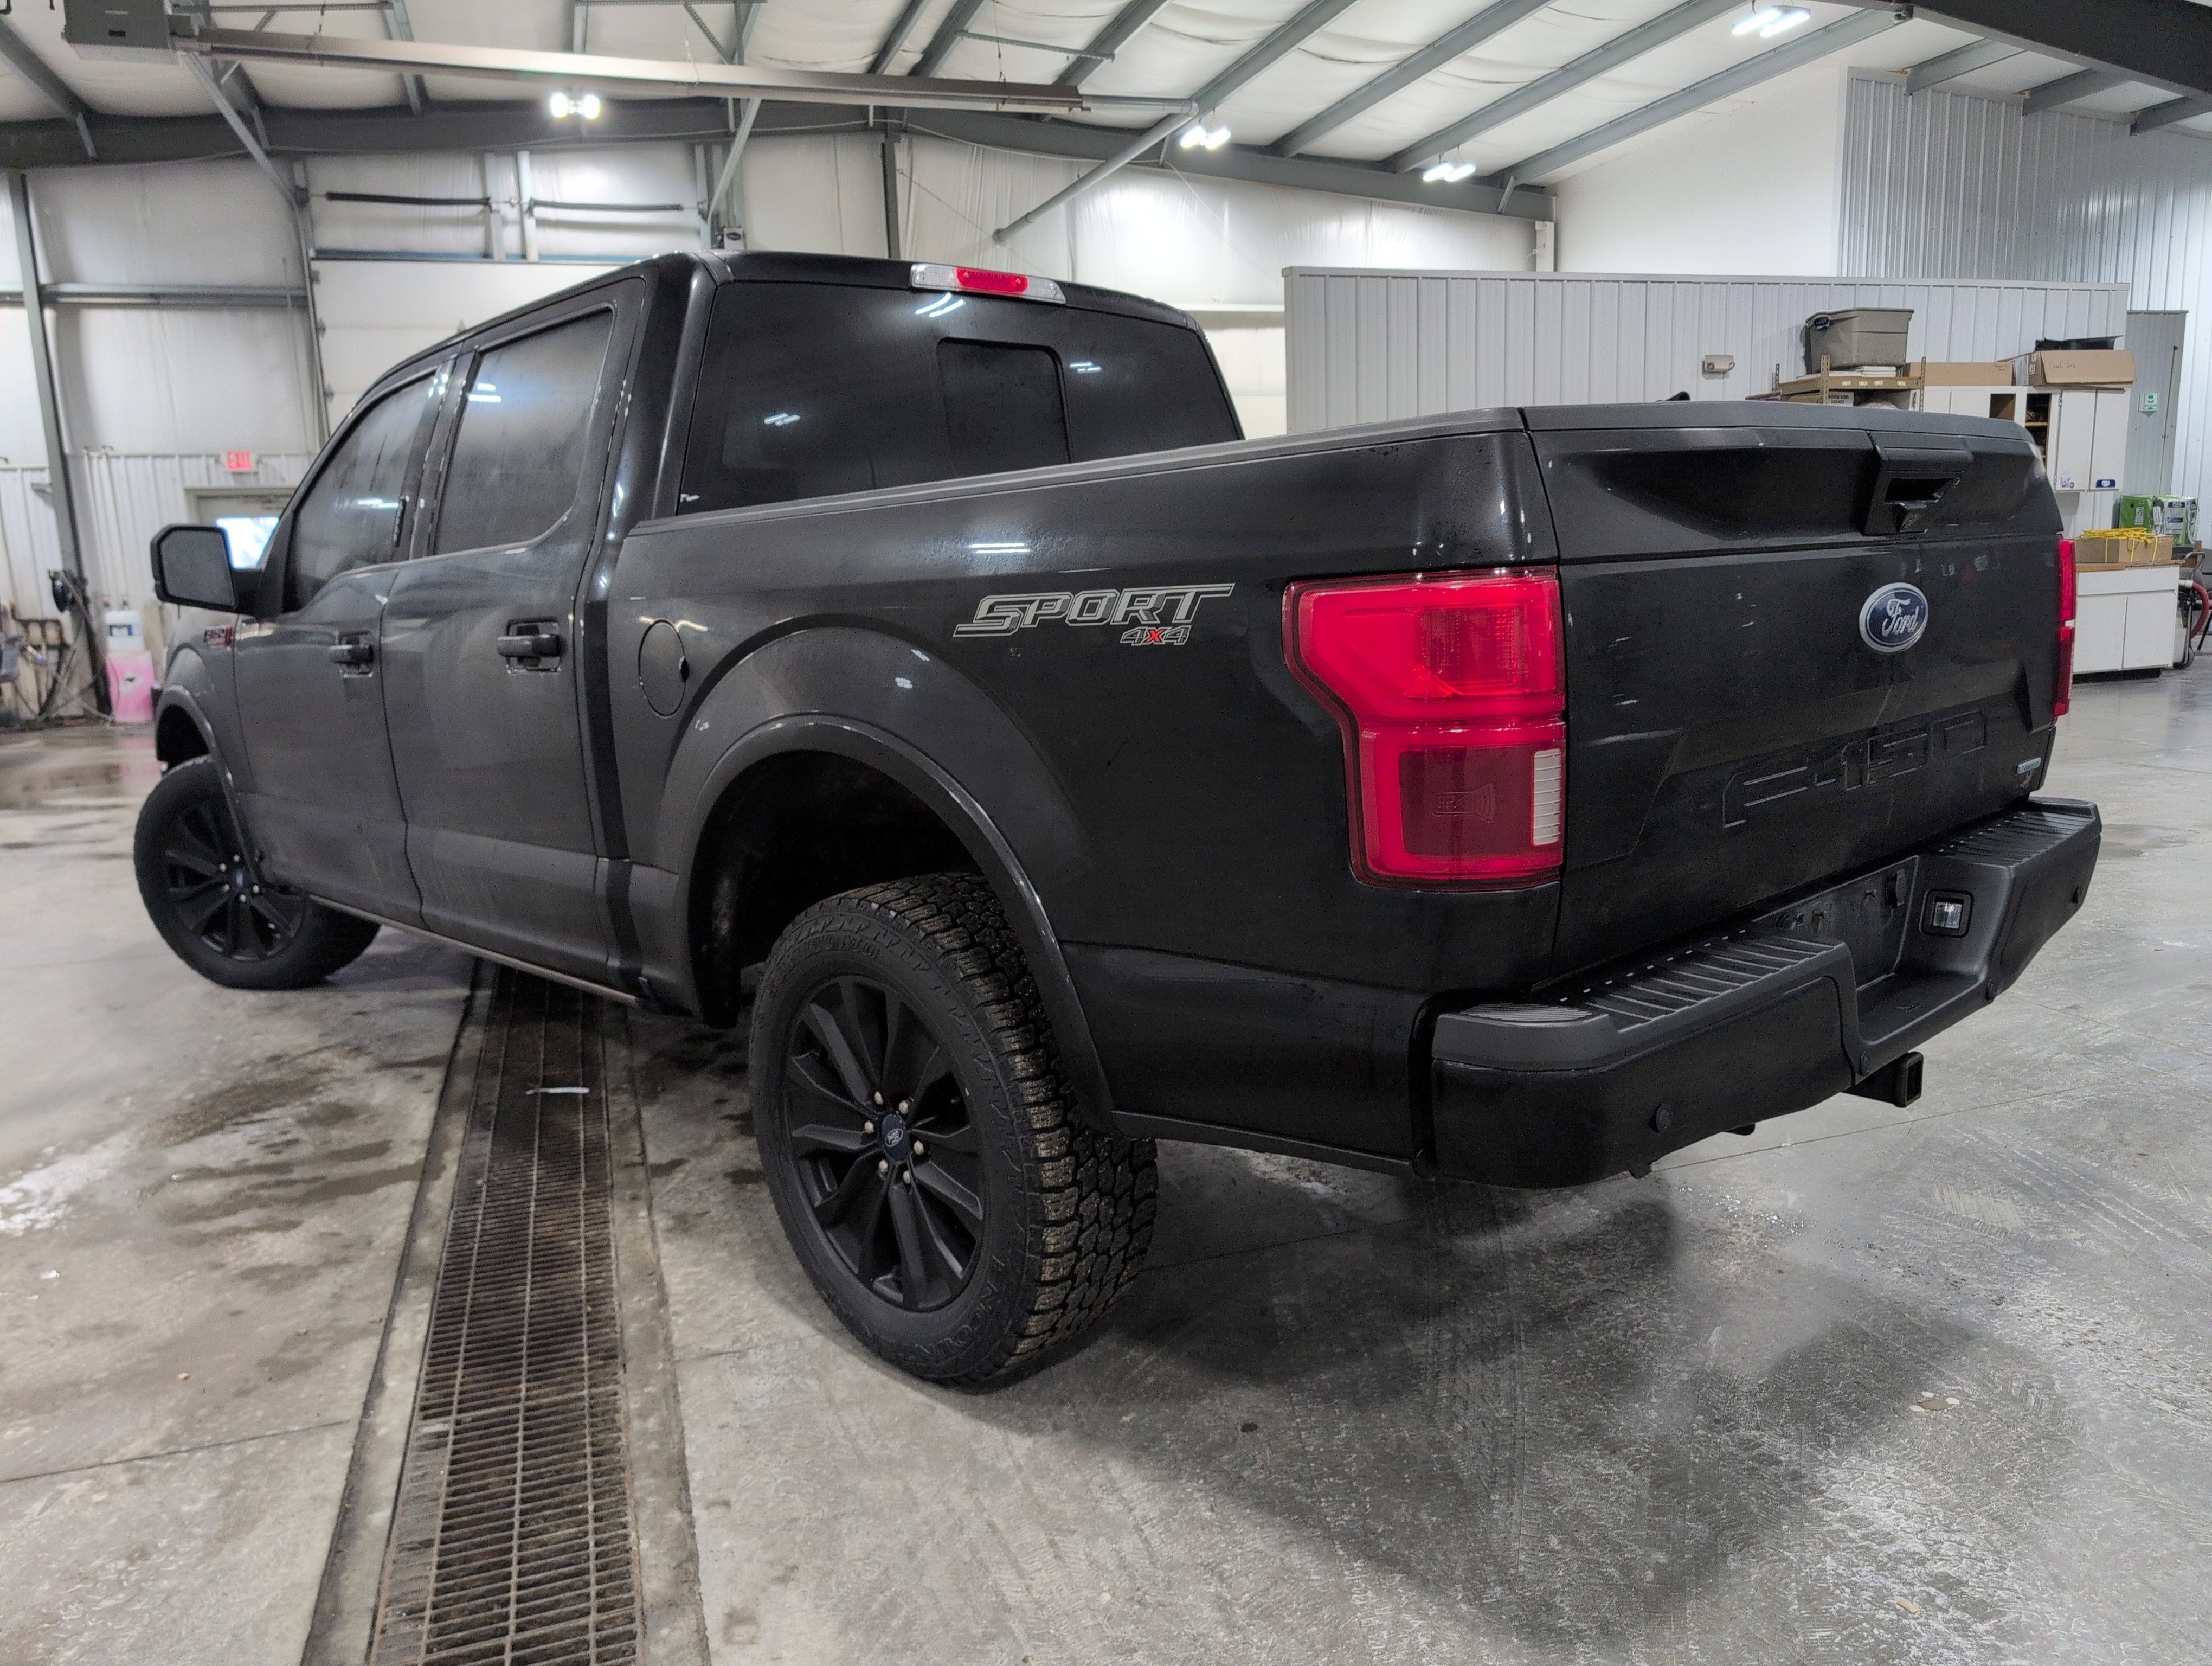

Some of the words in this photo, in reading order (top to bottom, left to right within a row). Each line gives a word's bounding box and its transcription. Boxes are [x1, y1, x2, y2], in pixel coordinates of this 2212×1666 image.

[953, 582, 1236, 637] SPORT
[1881, 597, 1920, 638] Ford
[1119, 625, 1192, 646] 4x4
